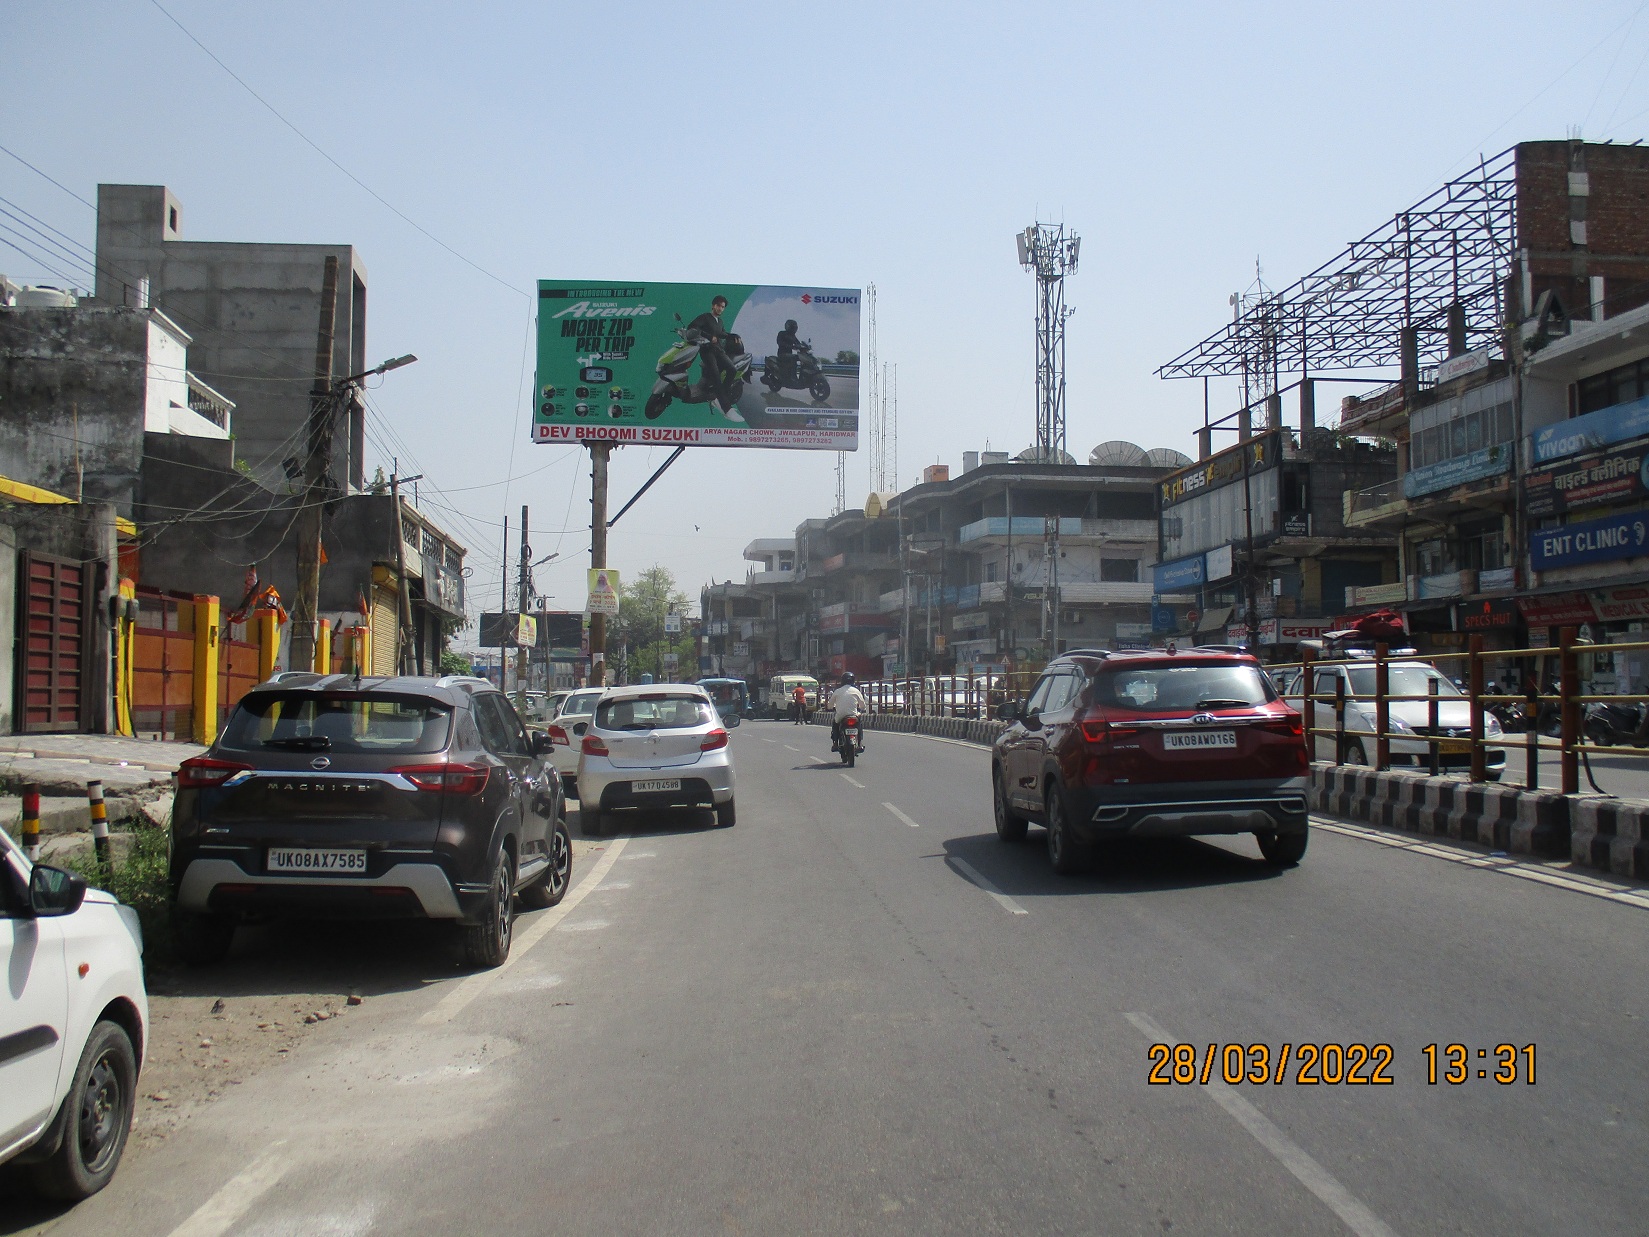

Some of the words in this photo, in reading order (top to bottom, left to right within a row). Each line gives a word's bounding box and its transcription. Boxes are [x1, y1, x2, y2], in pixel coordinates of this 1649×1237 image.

[814, 296, 858, 304] SUZUKI
[552, 301, 657, 318] Avenis
[560, 319, 606, 337] MORE
[608, 318, 634, 336] ZIP
[576, 337, 602, 352] PER
[604, 336, 636, 352] TRIP
[540, 426, 570, 438] DEV
[576, 426, 636, 440] BHOOMI
[642, 428, 698, 441] SUZUKI
[1543, 536, 1572, 557] ENT
[1576, 526, 1628, 552] CLINIC
[1465, 616, 1490, 628] SPECS
[1493, 613, 1511, 624] HUT
[1172, 734, 1235, 747] UK08AW0166
[267, 783, 366, 791] MAGNITE
[278, 852, 365, 868] UK08AX7585
